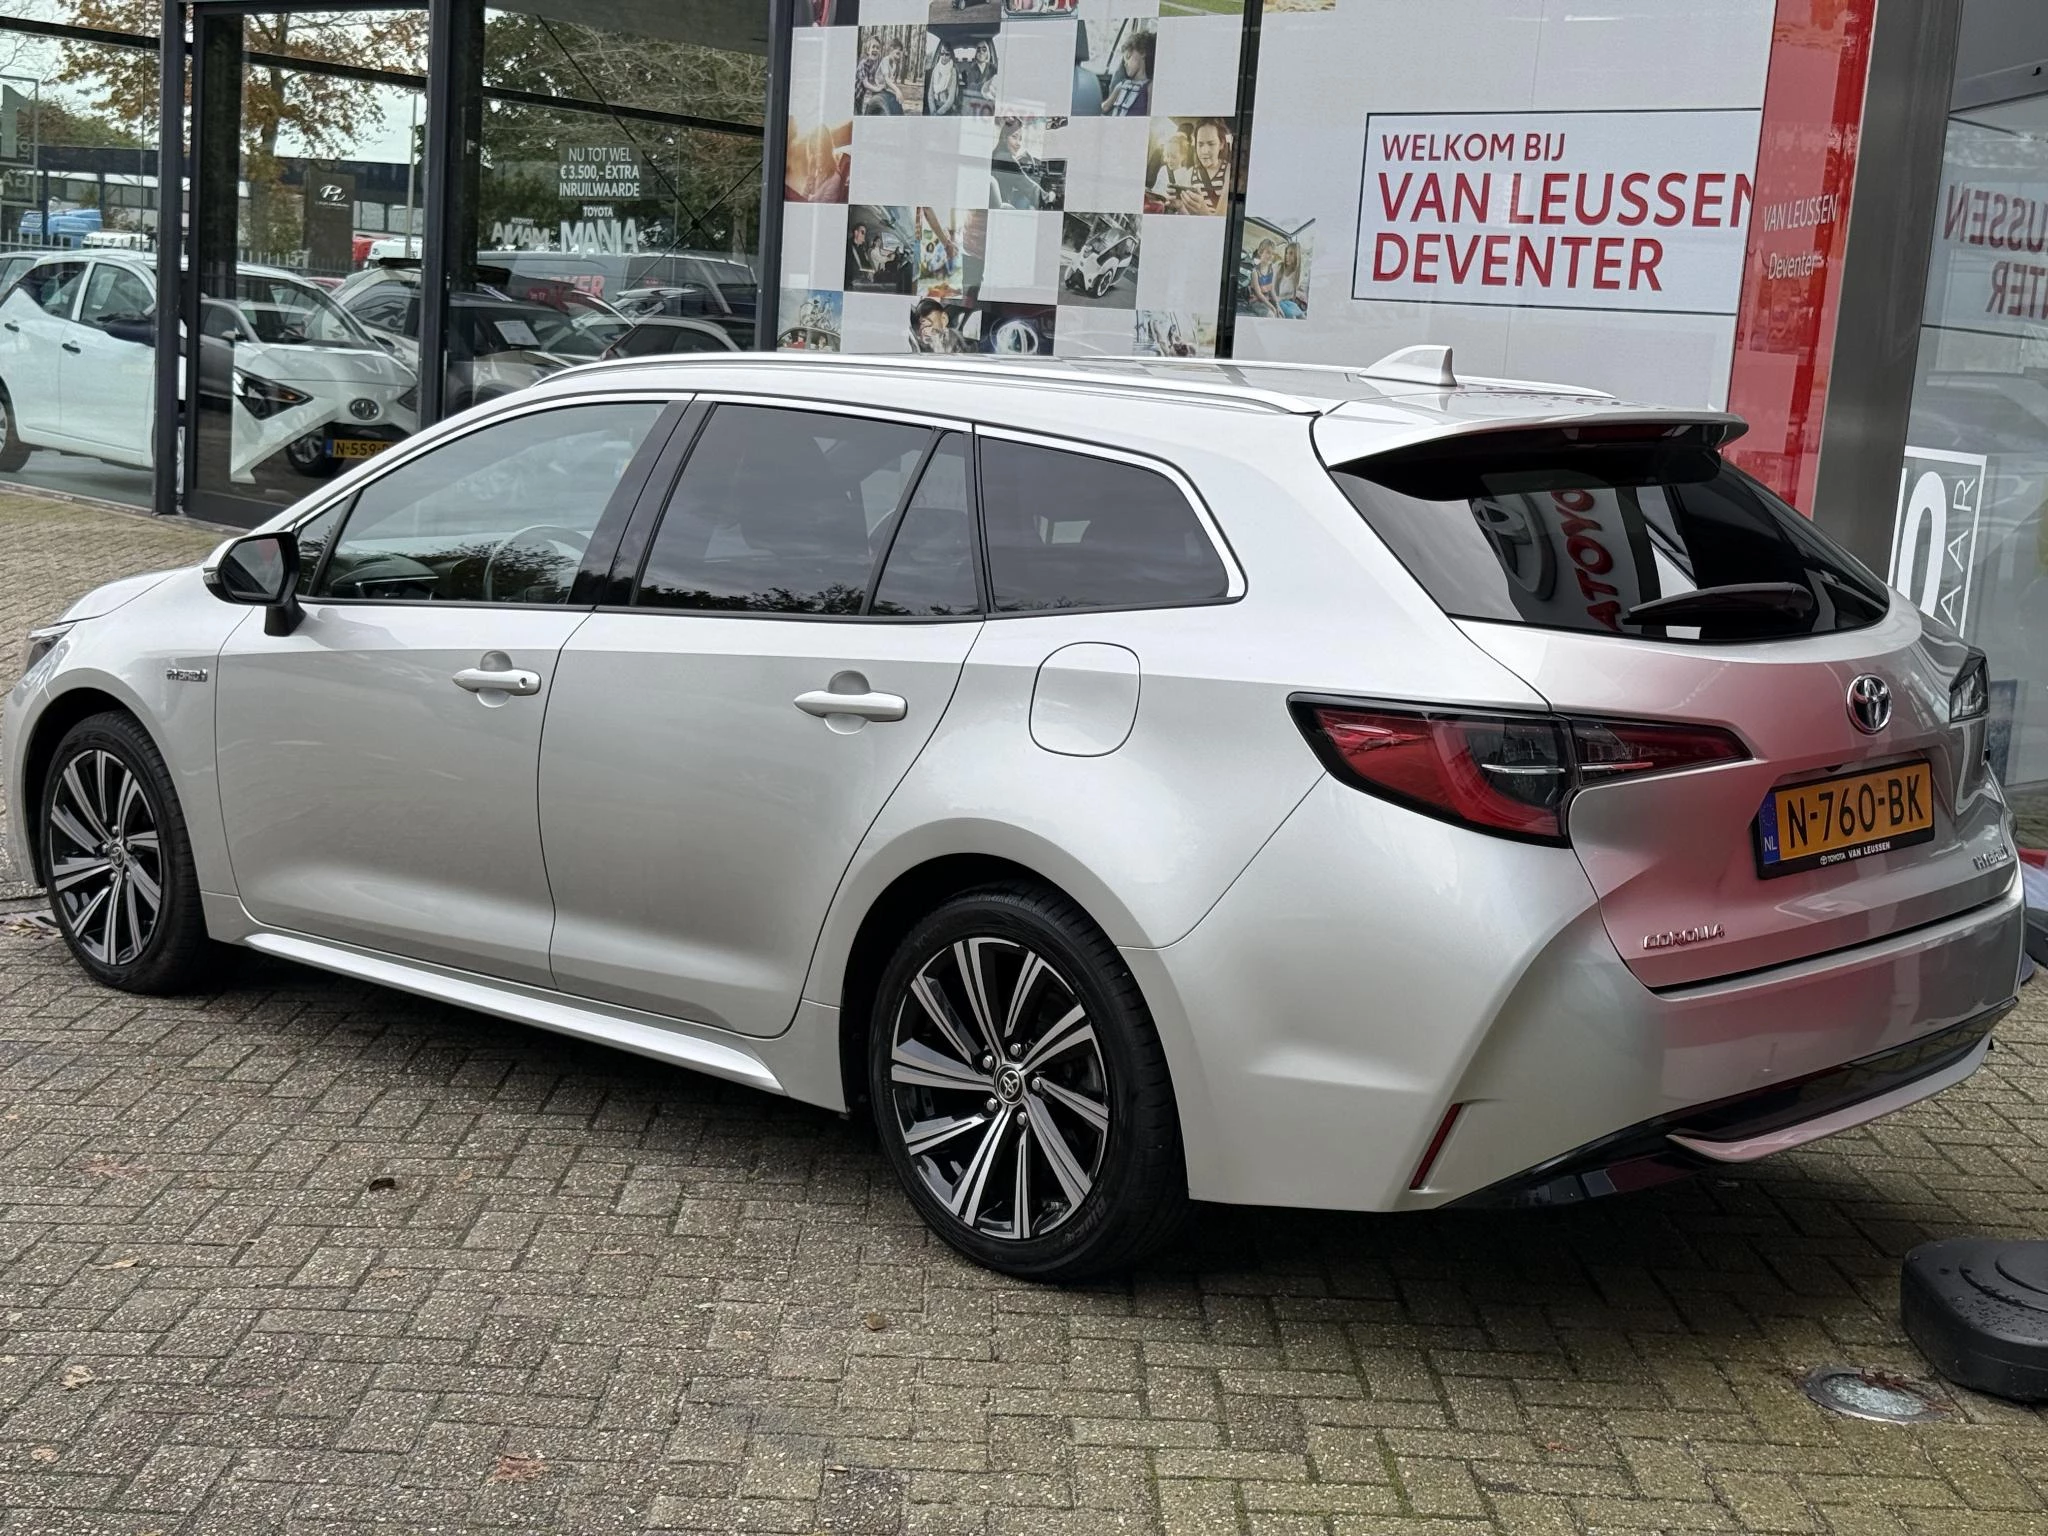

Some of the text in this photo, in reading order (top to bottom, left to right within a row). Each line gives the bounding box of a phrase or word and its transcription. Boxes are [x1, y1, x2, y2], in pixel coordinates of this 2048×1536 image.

[568, 147, 632, 162] NU TOT WEL
[1381, 133, 1566, 162] WELKOM BIJ
[559, 182, 640, 197] INRUILWAARDE
[1378, 172, 1491, 224] VAN
[583, 206, 614, 217] TOYOTA
[1764, 193, 1839, 232] VAN LEUSSEN
[560, 218, 640, 257] MANIA
[1372, 232, 1663, 291] DEVENTER
[1768, 251, 1816, 280] Deventer
[1787, 774, 1924, 849] N-760-BK
[1764, 835, 1778, 852] NL
[1848, 848, 1862, 859] VAN
[1863, 841, 1891, 855] LEUSSEN
